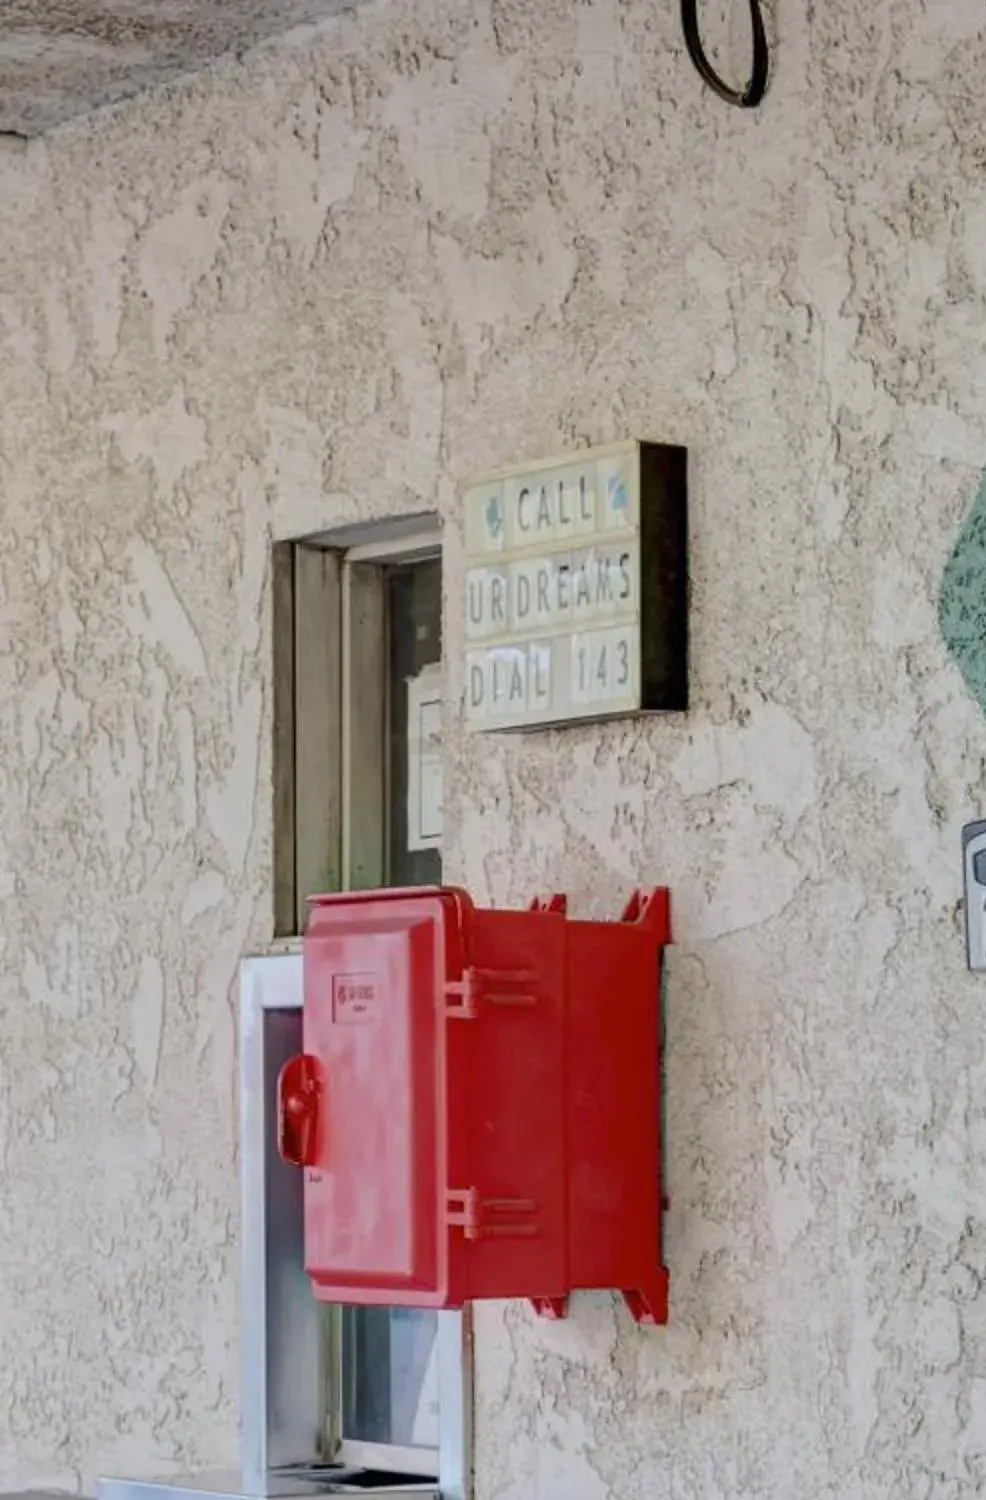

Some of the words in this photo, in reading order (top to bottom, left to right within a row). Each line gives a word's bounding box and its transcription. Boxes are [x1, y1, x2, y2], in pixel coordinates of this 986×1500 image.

[517, 476, 592, 531] CALL
[470, 655, 546, 707] DIAL
[578, 640, 629, 691] 143
